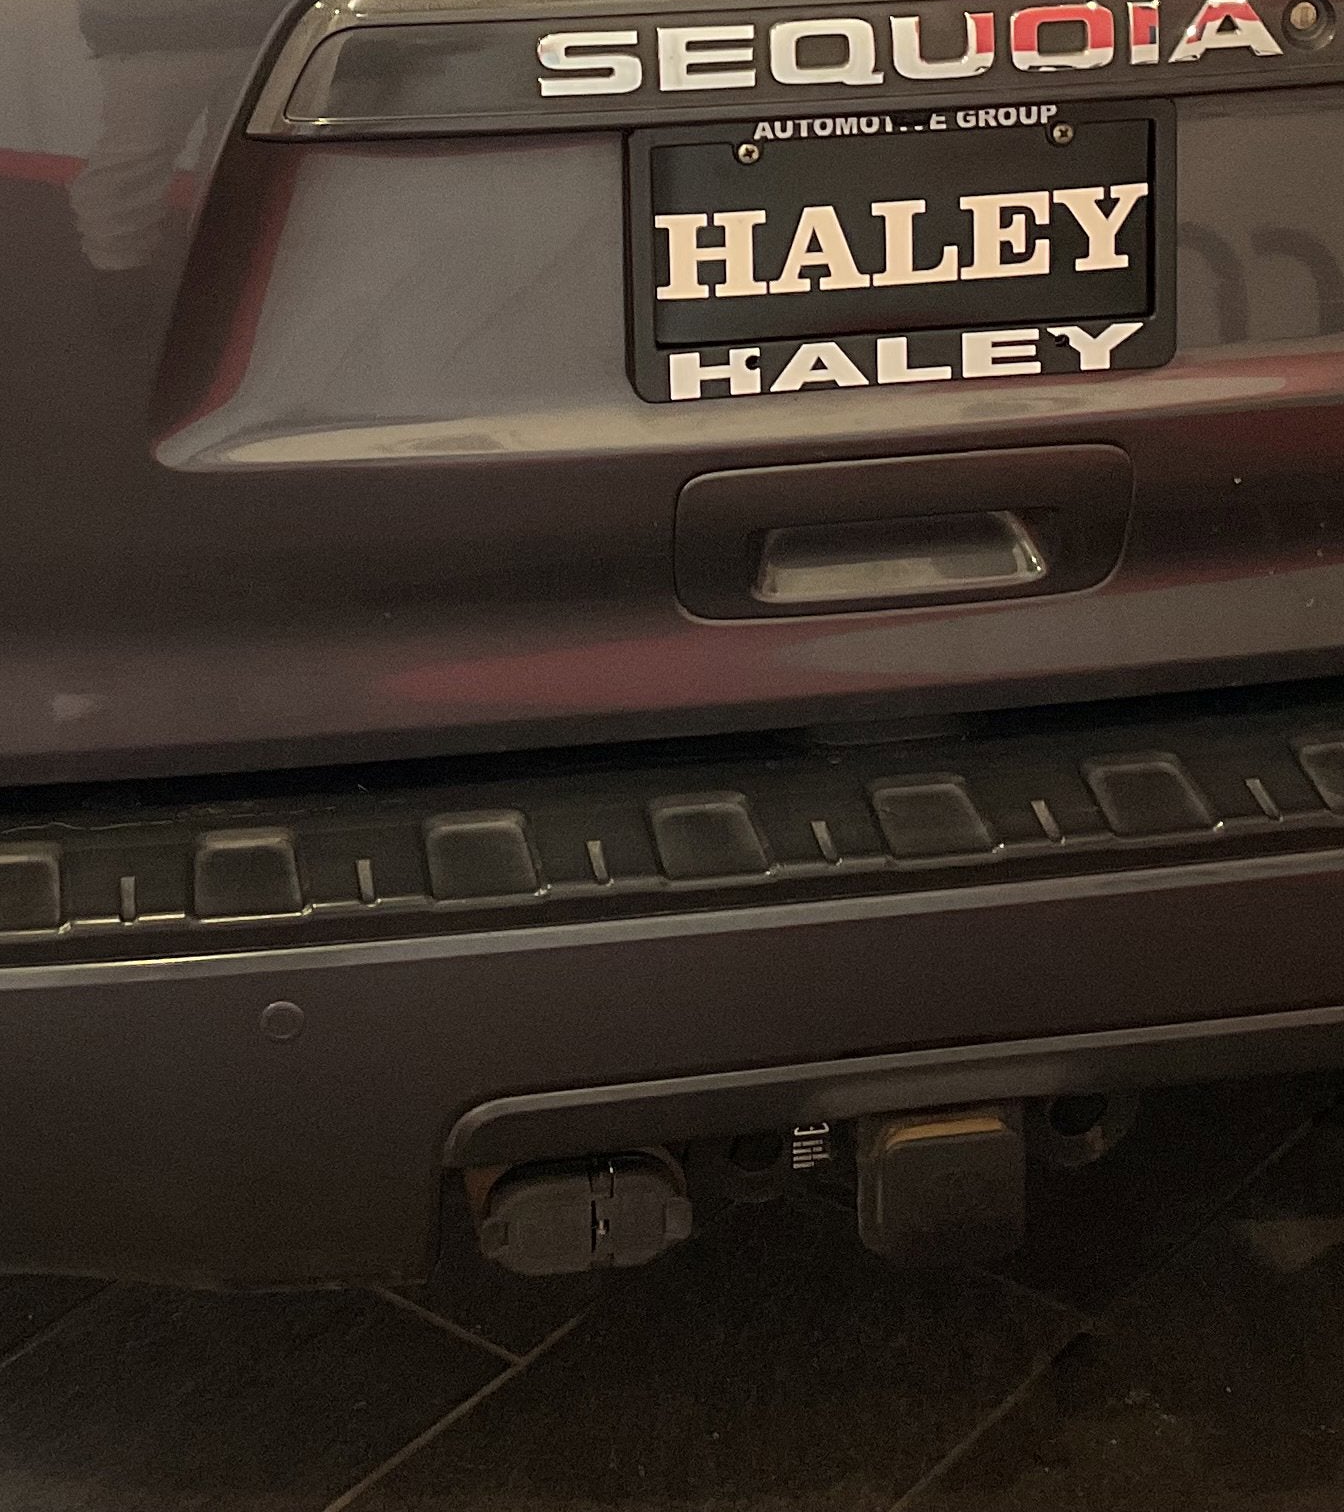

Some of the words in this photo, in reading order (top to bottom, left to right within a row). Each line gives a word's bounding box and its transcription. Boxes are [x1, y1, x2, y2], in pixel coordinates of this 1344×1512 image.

[956, 103, 1058, 129] GROUP
[654, 182, 1148, 300] HALEY
[669, 322, 1144, 401] HALEY
